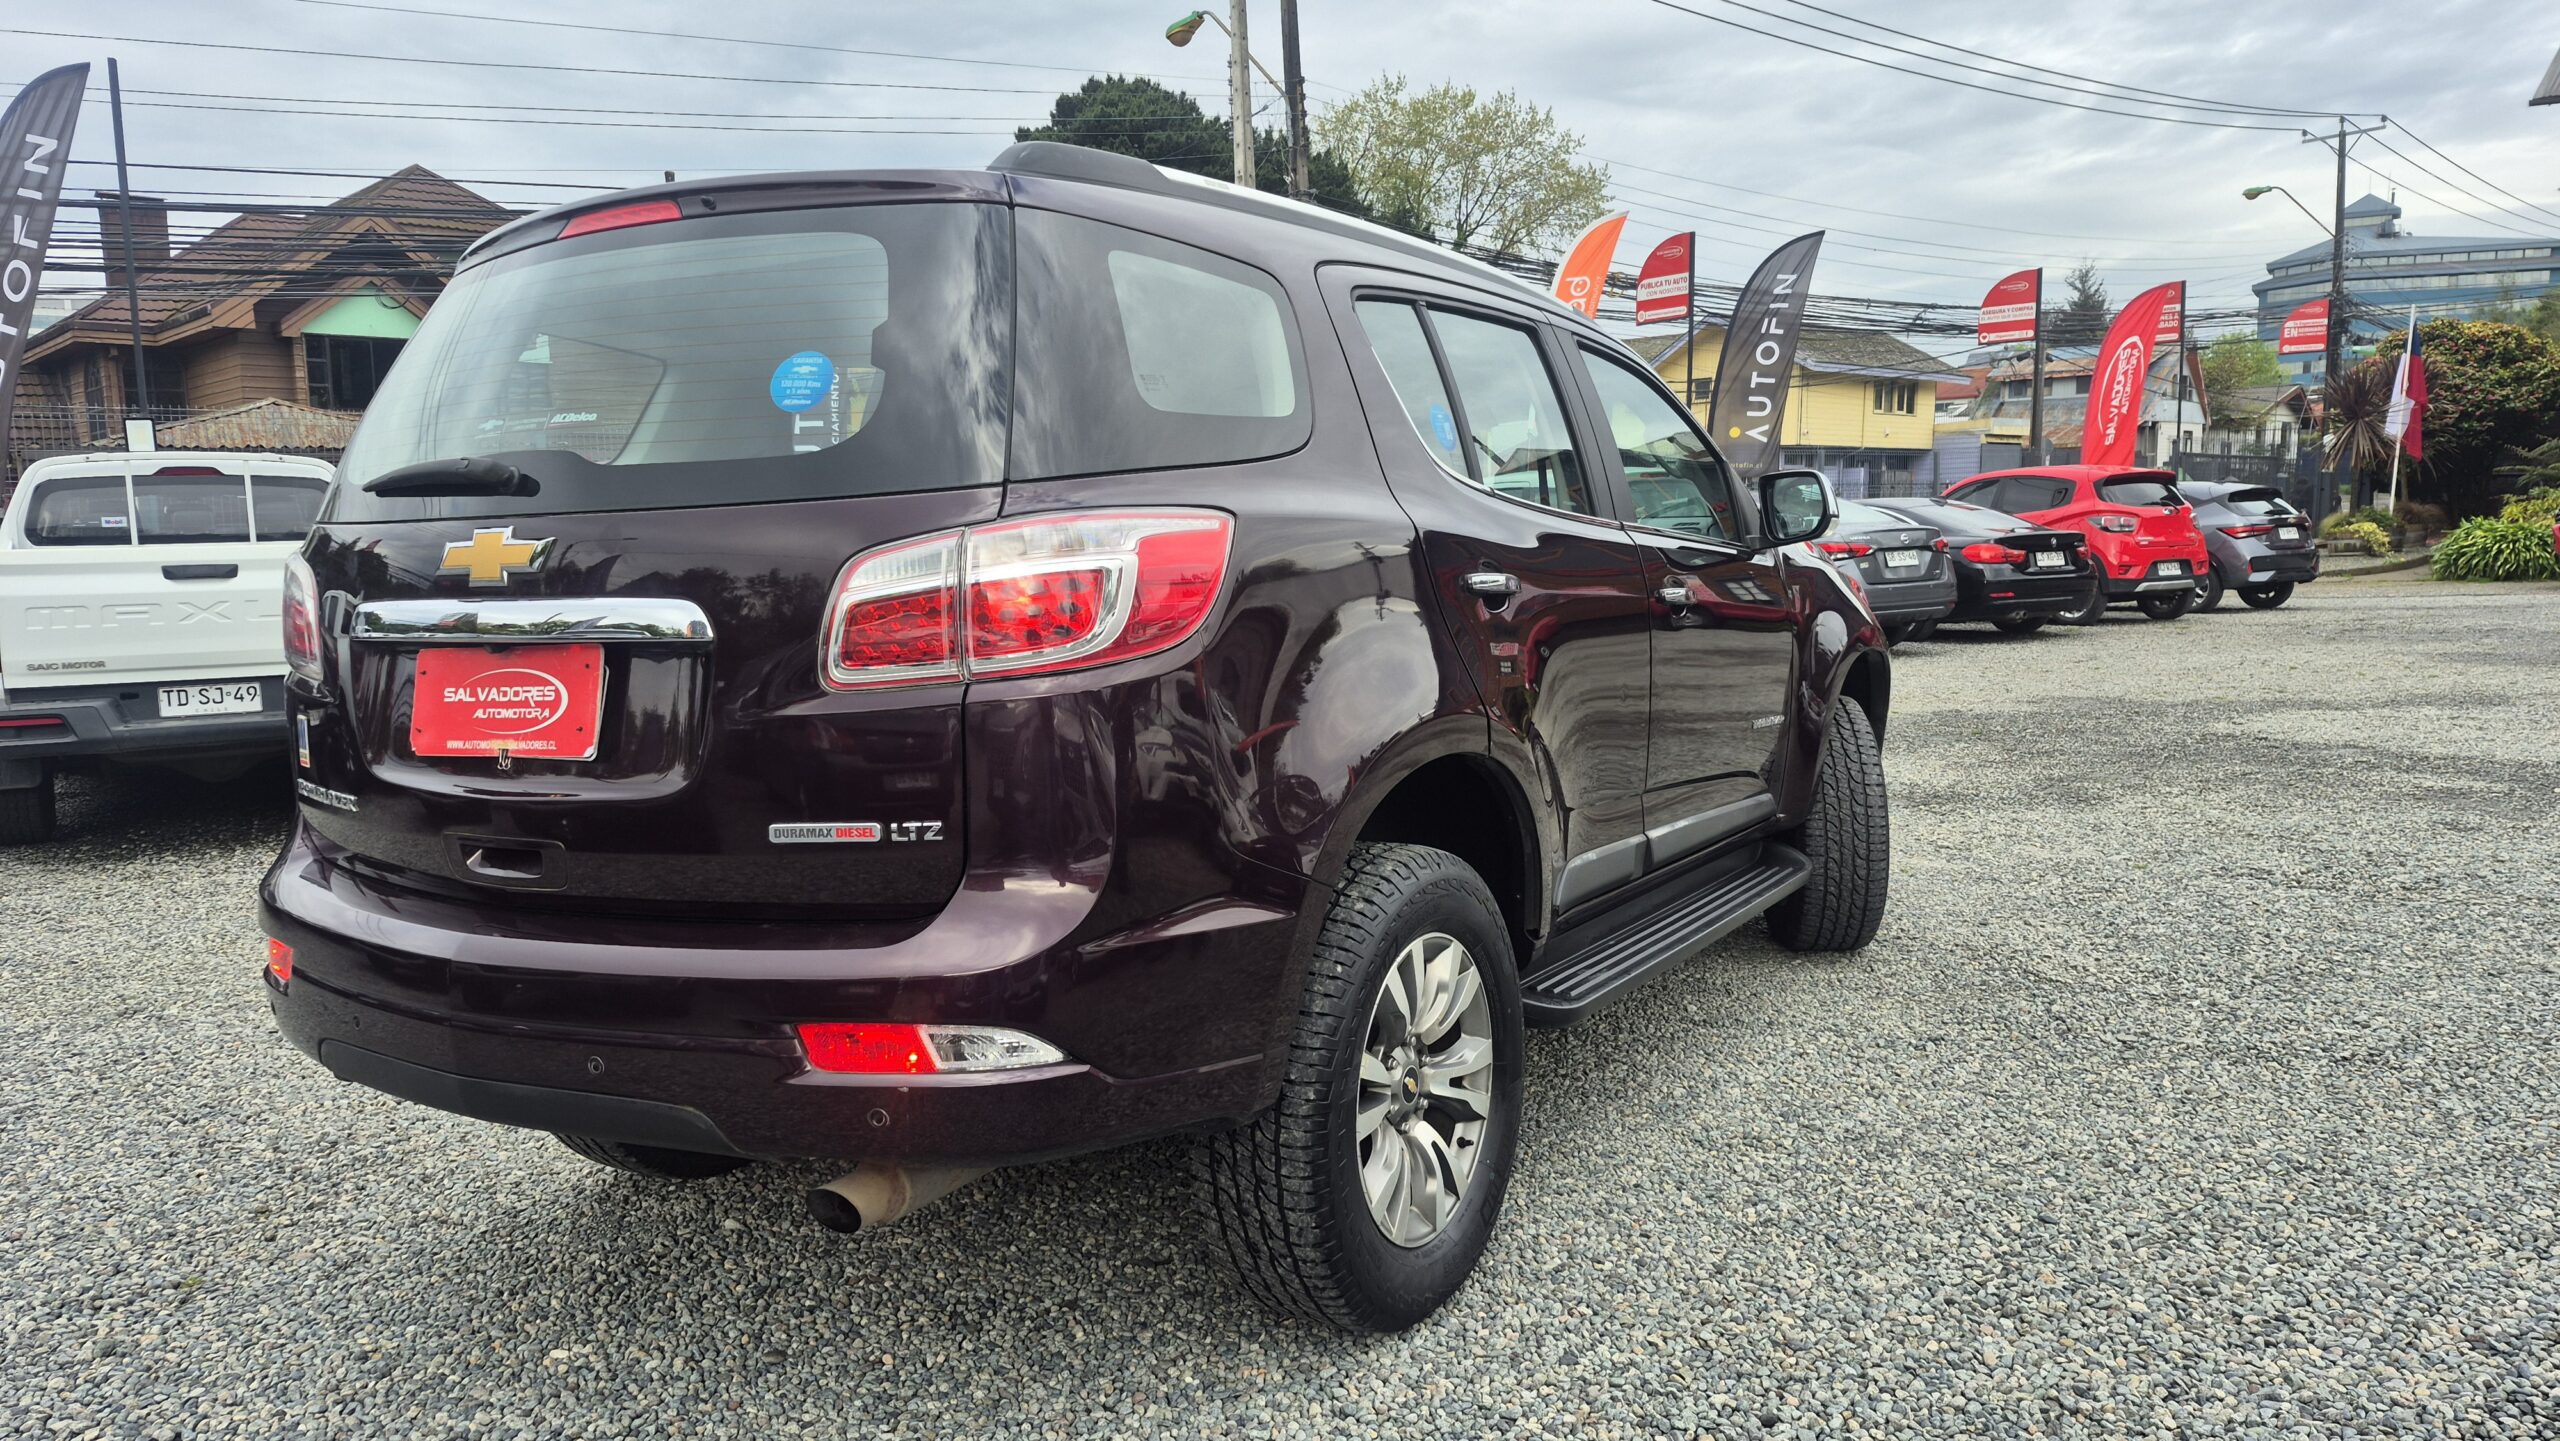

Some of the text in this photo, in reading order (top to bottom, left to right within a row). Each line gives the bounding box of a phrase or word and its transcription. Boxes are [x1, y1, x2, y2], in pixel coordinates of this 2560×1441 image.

[0, 133, 58, 386] TOFIN
[1640, 276, 1688, 290] PUBLICA TU AUTO
[1645, 286, 1688, 298] CON NOSOTROS
[2284, 327, 2298, 338] EN
[1745, 273, 1798, 443] AUTOFIN
[2104, 347, 2132, 446] SALVADORES
[831, 373, 840, 444] CIAMIENTO
[26, 660, 106, 672] SAIC MOTOR
[443, 685, 556, 707] SALVADORES
[472, 707, 550, 720] AUTOMOTORA
[773, 821, 944, 842] DURAMAX DIESEL LTZ
